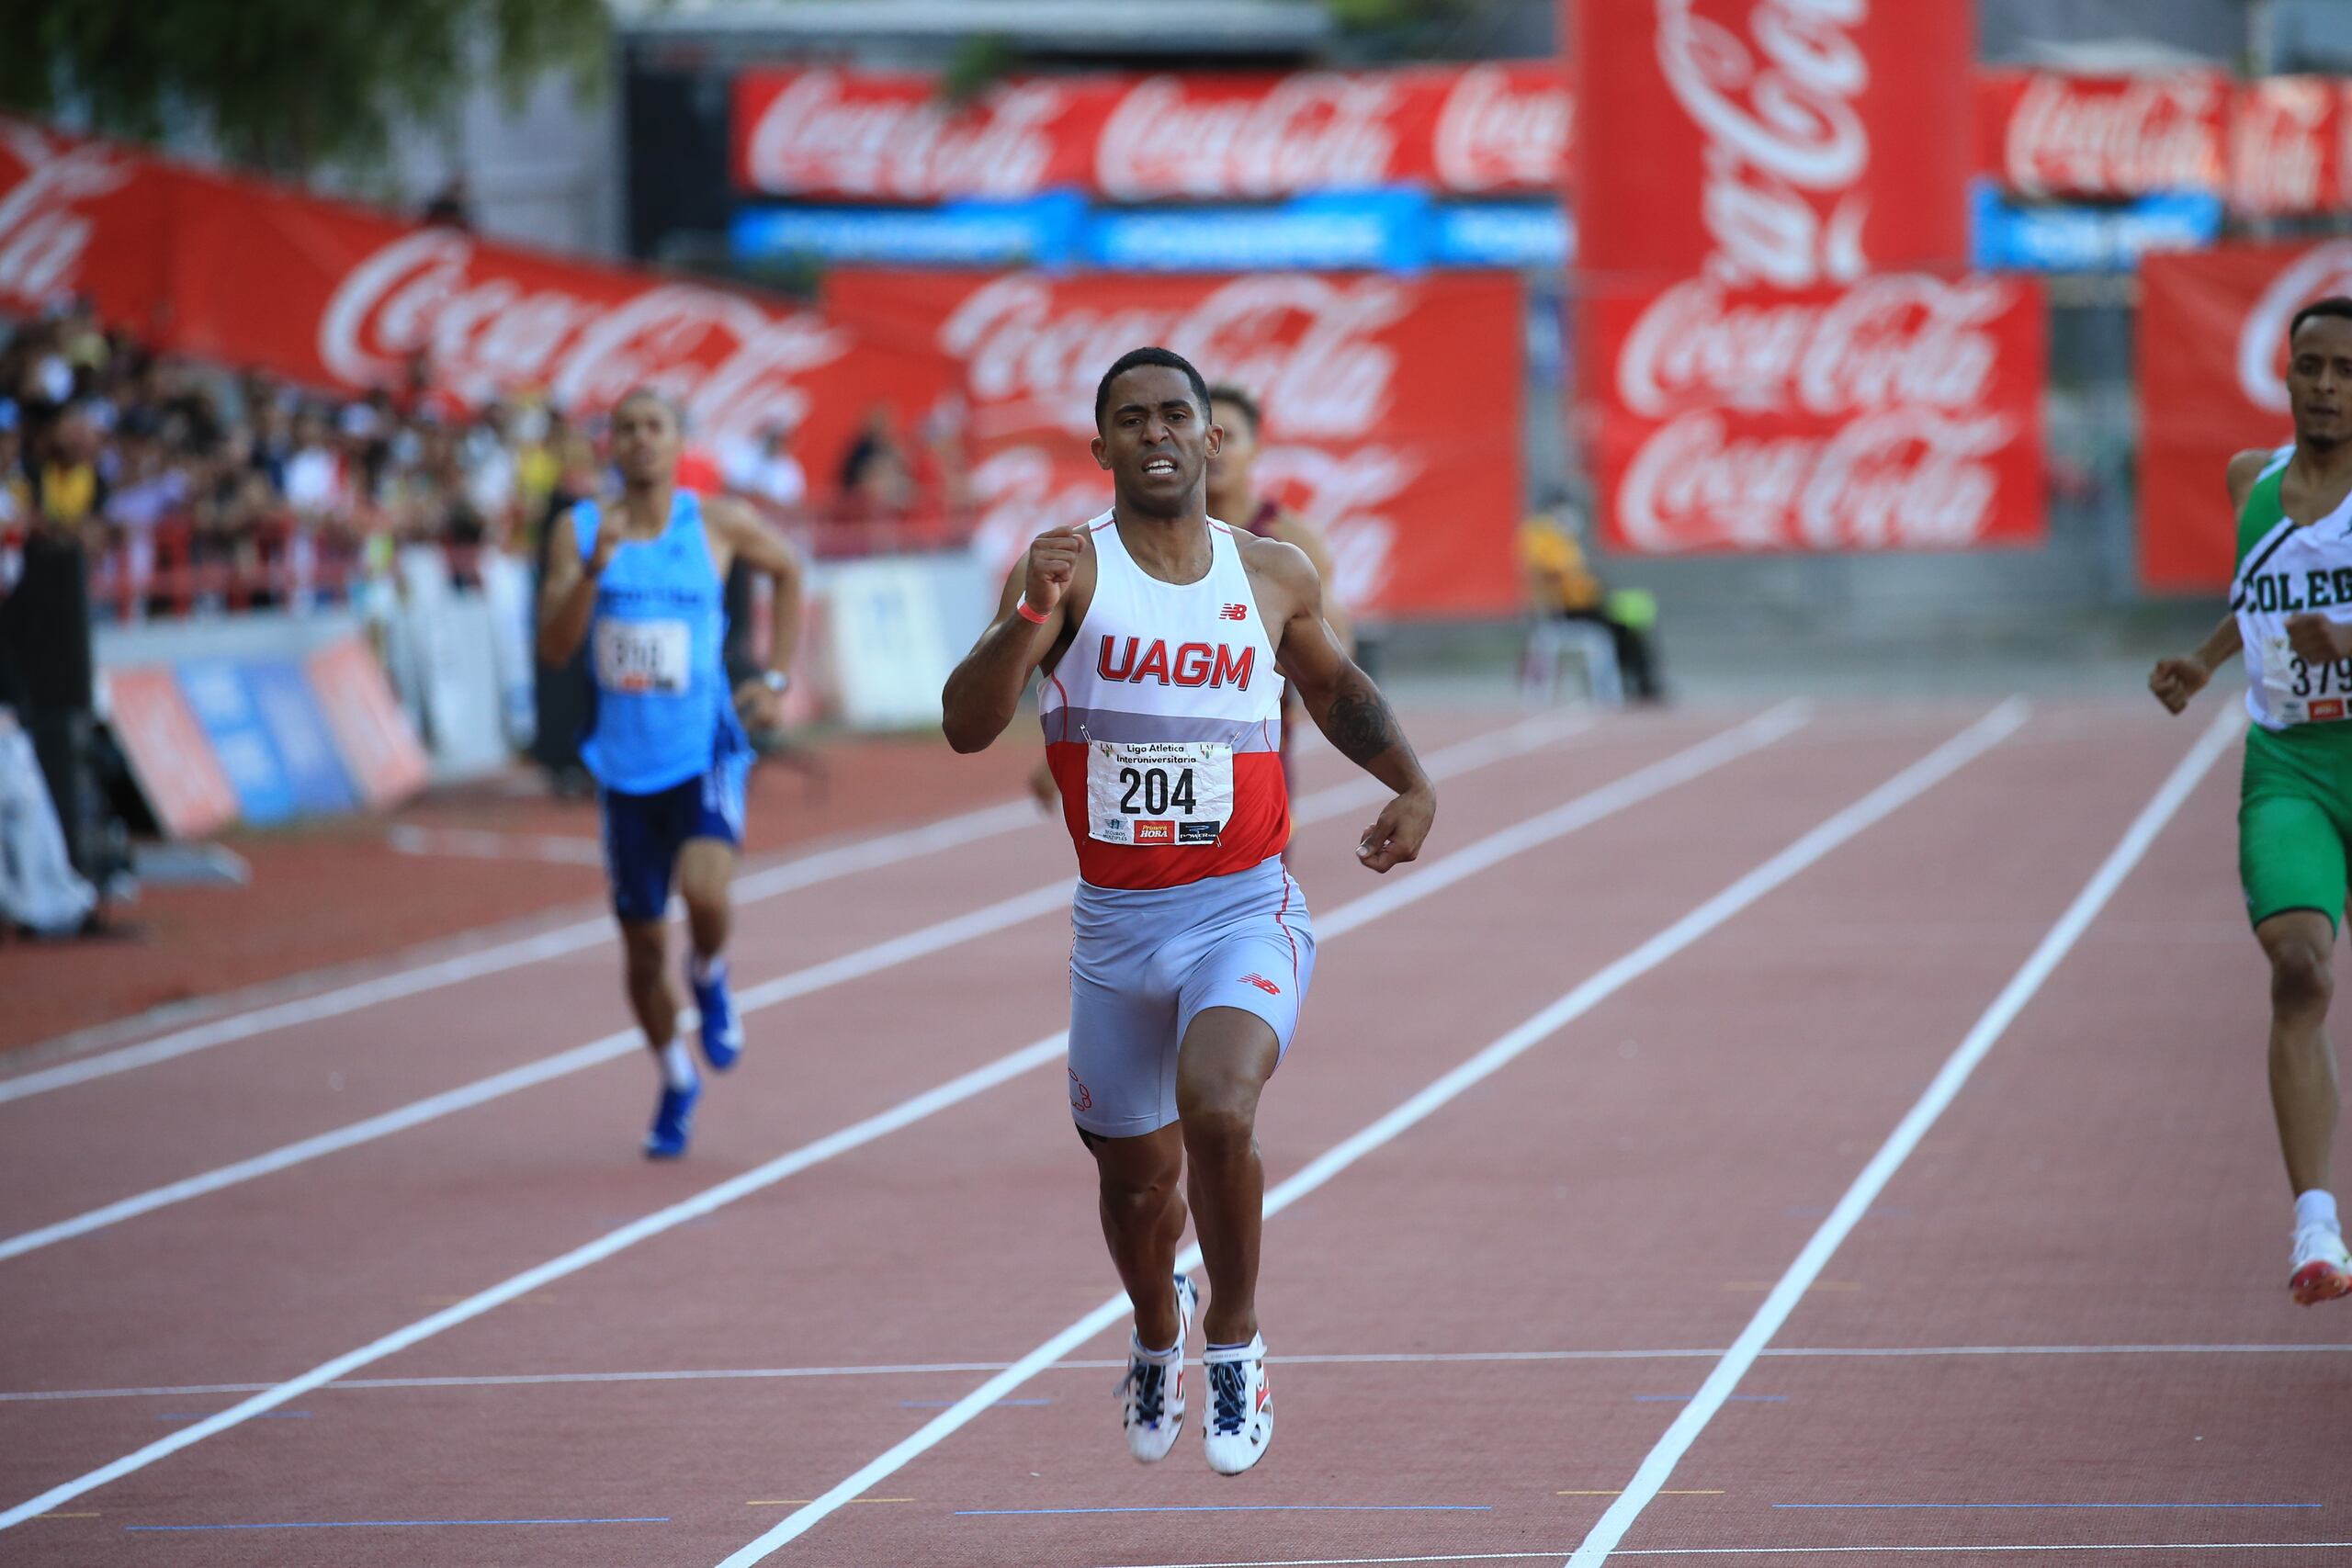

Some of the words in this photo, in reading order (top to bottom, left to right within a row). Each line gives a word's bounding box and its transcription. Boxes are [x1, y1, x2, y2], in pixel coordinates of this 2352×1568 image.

[1097, 635, 1256, 692] UAGM
[1116, 754, 1196, 763] Interuniversitaria
[1126, 744, 1148, 755] Liga
[1149, 743, 1184, 752] Atletica
[1120, 767, 1196, 815] 204
